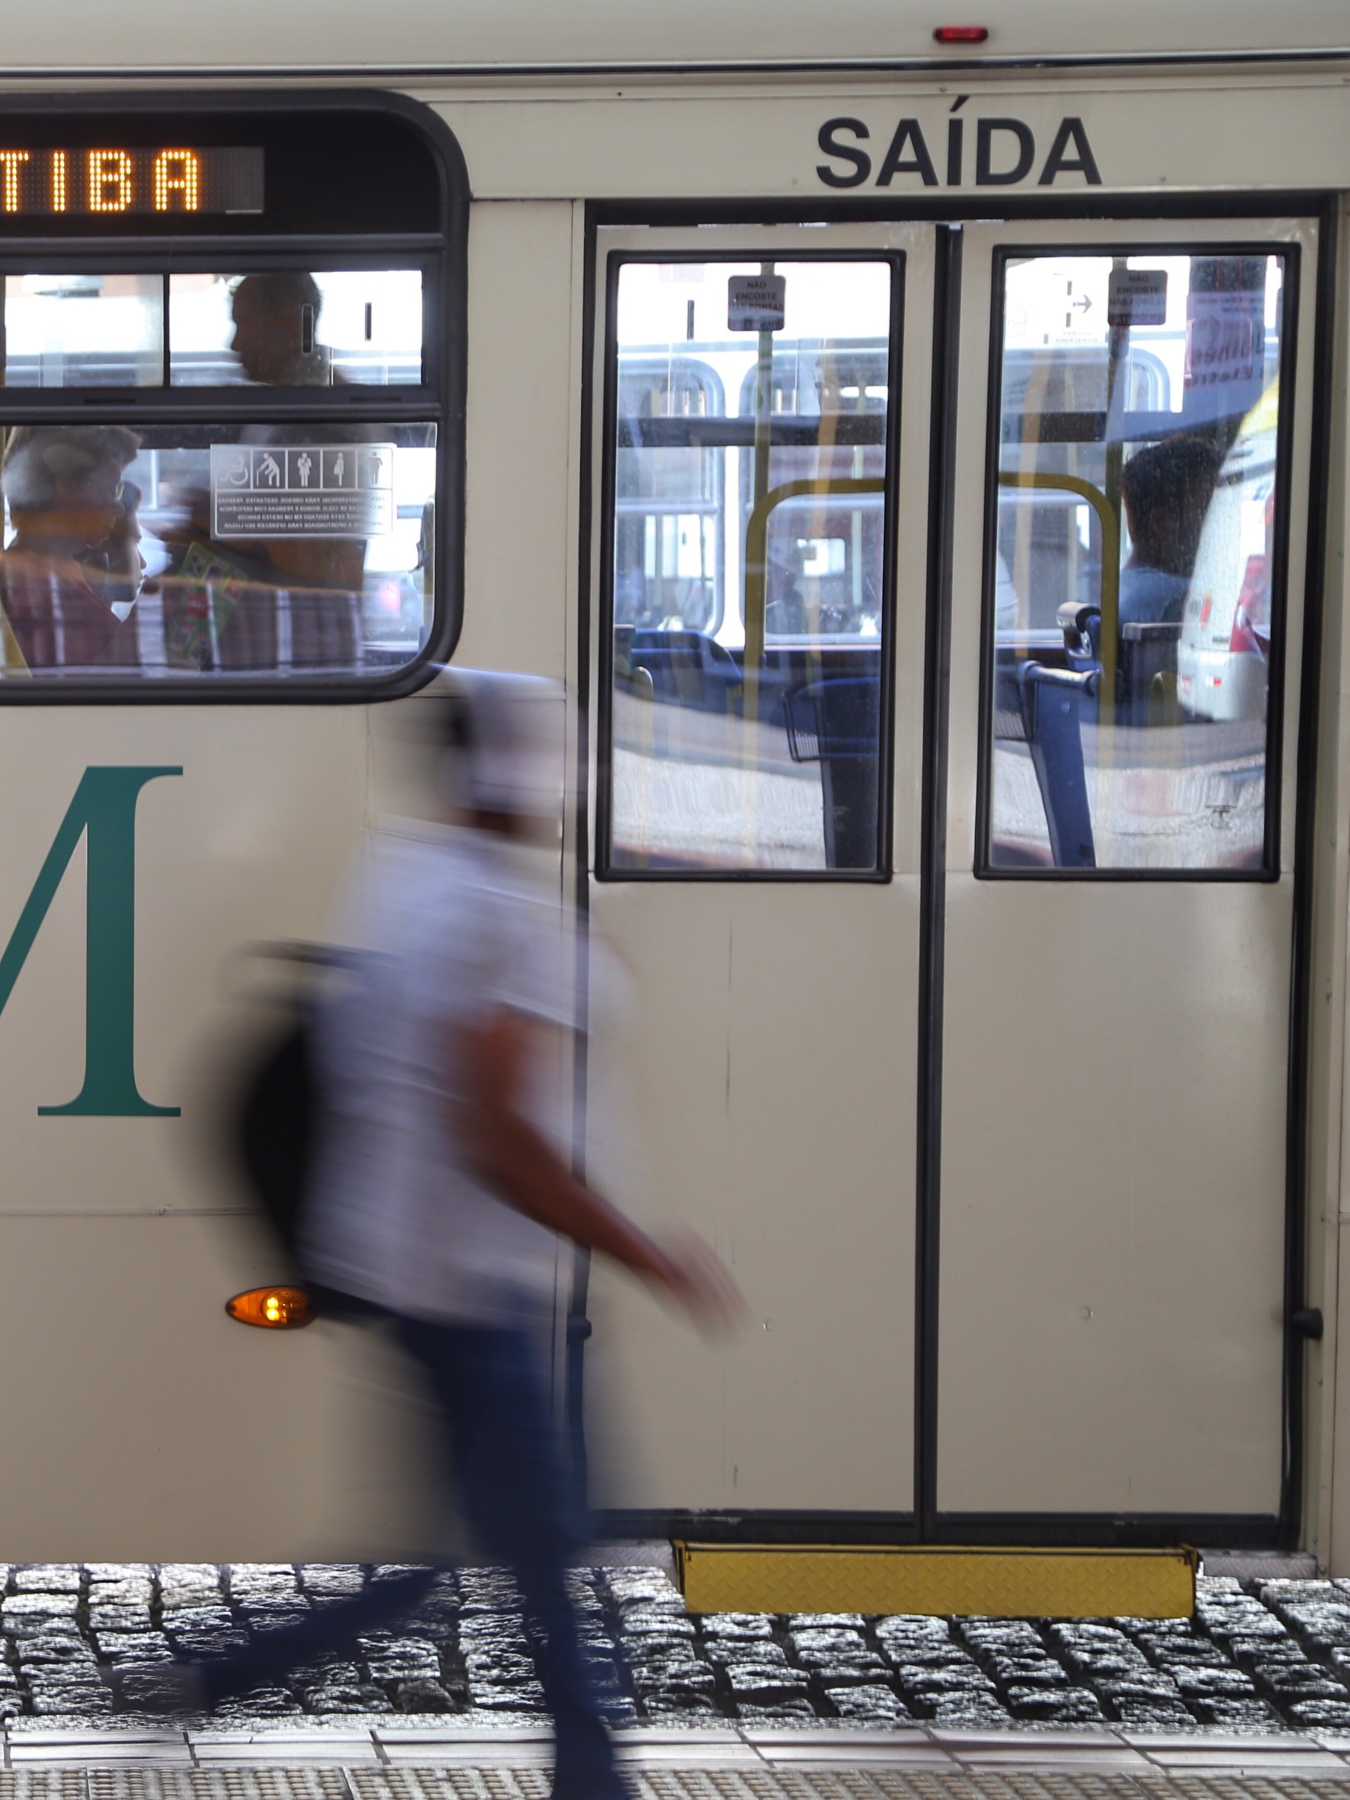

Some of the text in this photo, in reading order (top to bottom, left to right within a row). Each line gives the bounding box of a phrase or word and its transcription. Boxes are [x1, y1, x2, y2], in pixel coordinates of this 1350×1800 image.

[816, 95, 1102, 188] SAÍDA
[747, 280, 767, 289] NÃO
[735, 292, 777, 300] ENCOSTE
